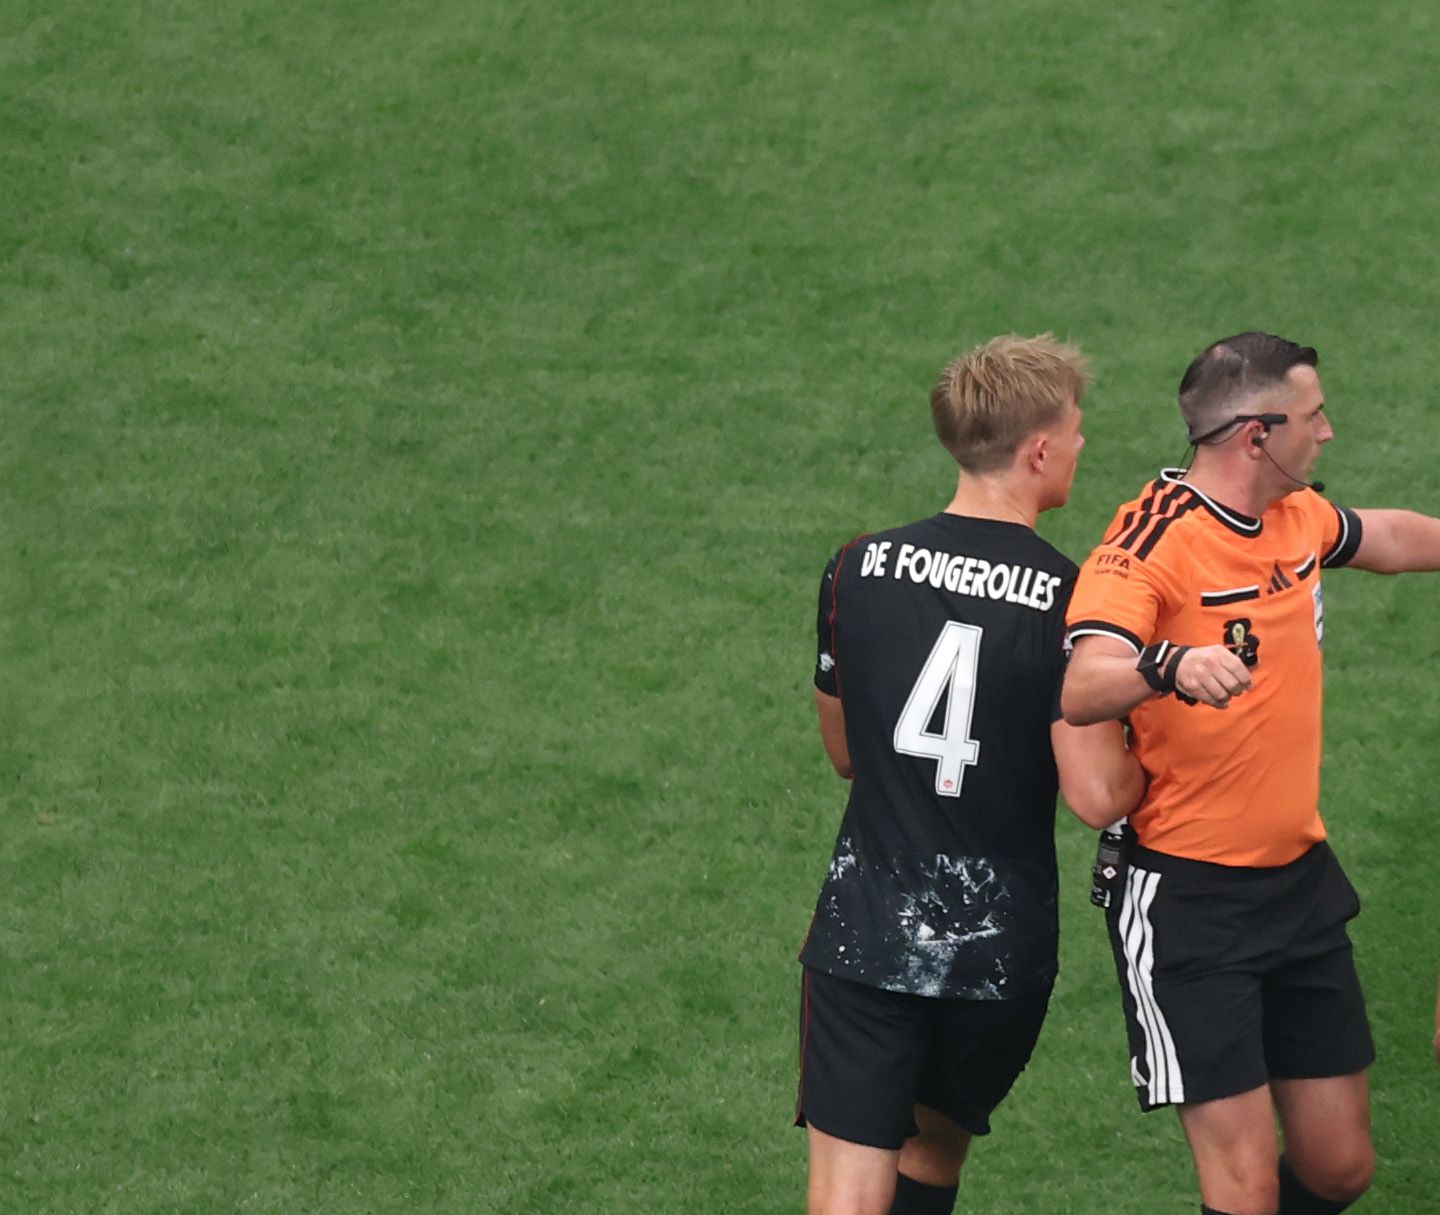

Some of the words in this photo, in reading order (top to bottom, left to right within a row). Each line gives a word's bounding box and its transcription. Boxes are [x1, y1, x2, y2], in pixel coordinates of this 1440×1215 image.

[861, 542, 890, 577] DE
[895, 544, 1061, 611] FOUGEROLLES
[1097, 553, 1129, 570] FIFA
[893, 620, 984, 798] 4
